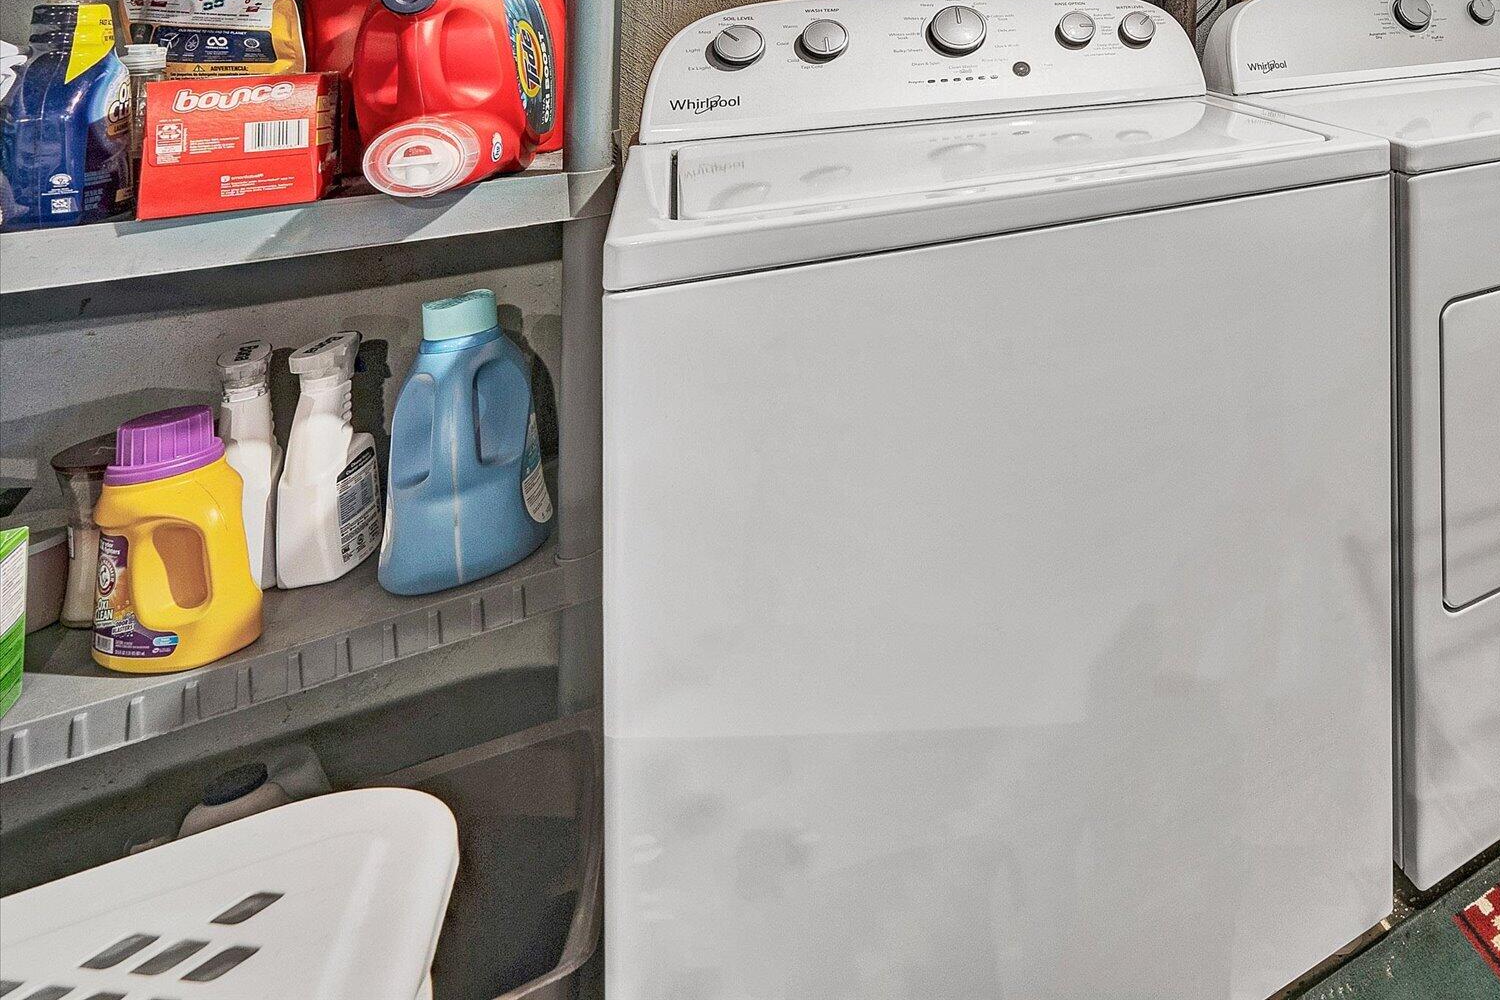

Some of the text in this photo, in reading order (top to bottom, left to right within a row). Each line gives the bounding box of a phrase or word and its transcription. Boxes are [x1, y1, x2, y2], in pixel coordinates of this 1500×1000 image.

[520, 29, 541, 90] Tide
[538, 31, 550, 90] BOOST
[1247, 60, 1287, 74] Whirlpool
[174, 83, 293, 112] bounce
[669, 95, 740, 114] Whirlpool
